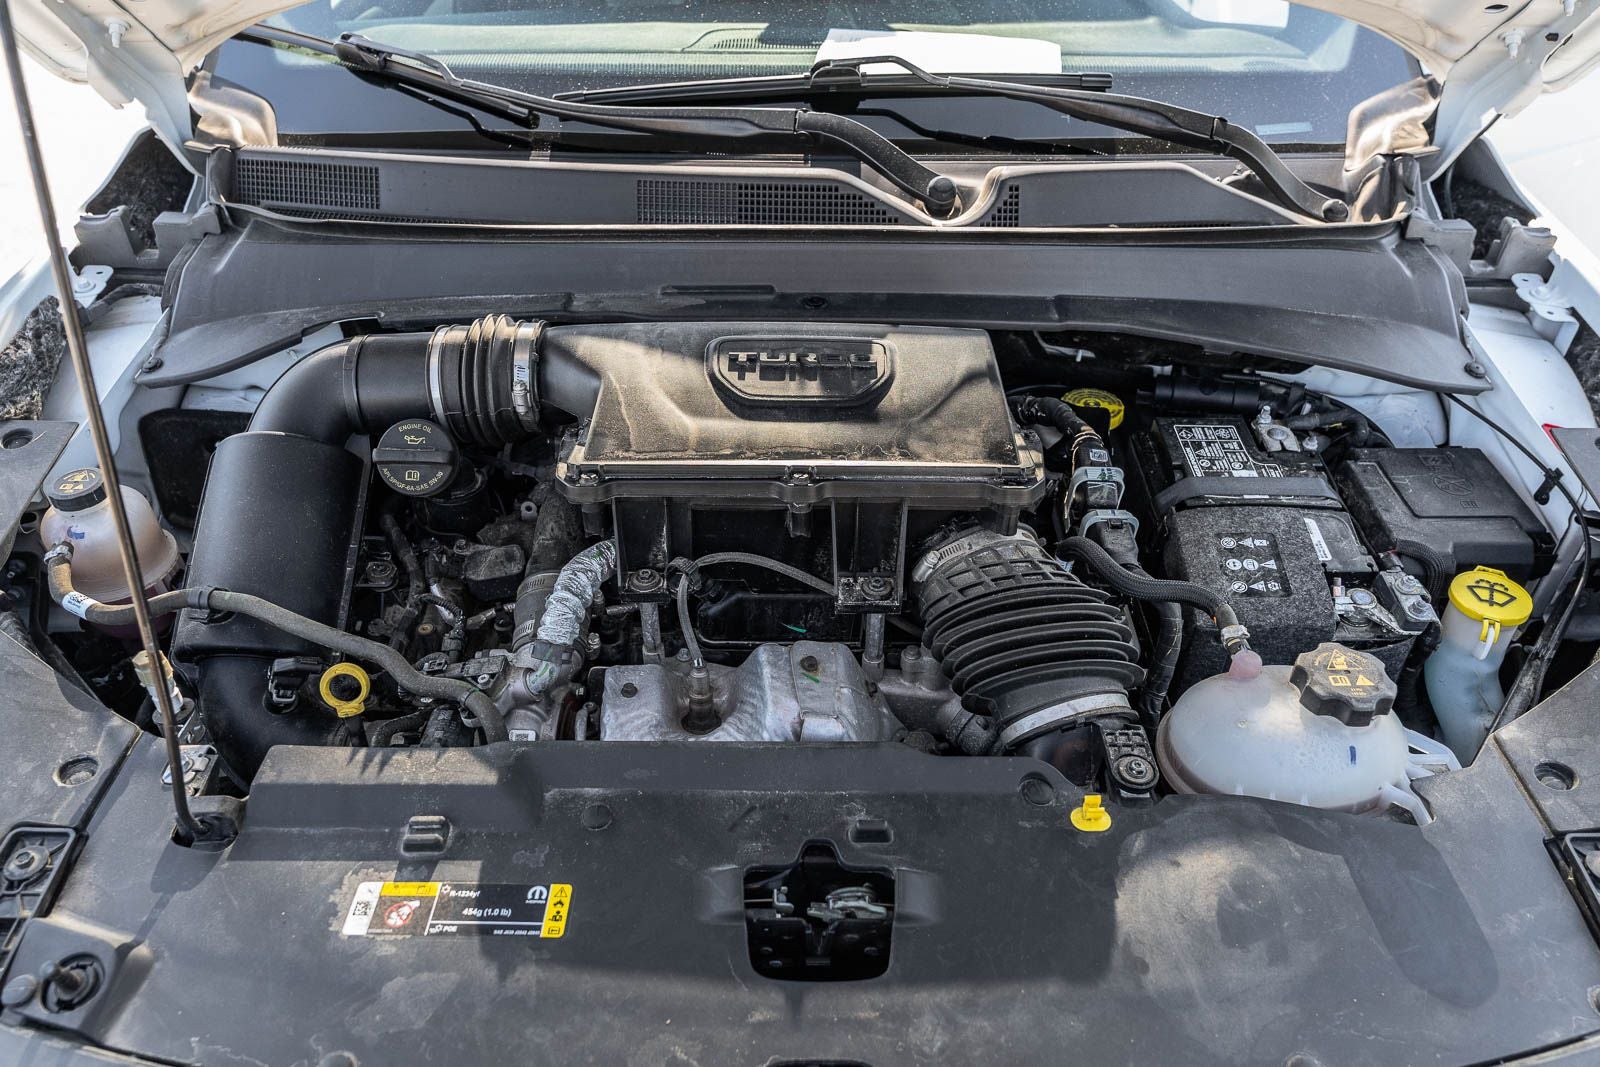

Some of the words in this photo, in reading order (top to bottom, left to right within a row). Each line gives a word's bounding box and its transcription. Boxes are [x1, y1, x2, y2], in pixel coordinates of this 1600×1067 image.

[728, 351, 878, 378] TURBO
[398, 423, 422, 433] ENGINE
[422, 425, 432, 434] OIL
[462, 908, 482, 917] 454g
[484, 908, 499, 917] (1.0
[500, 908, 512, 918] lb)
